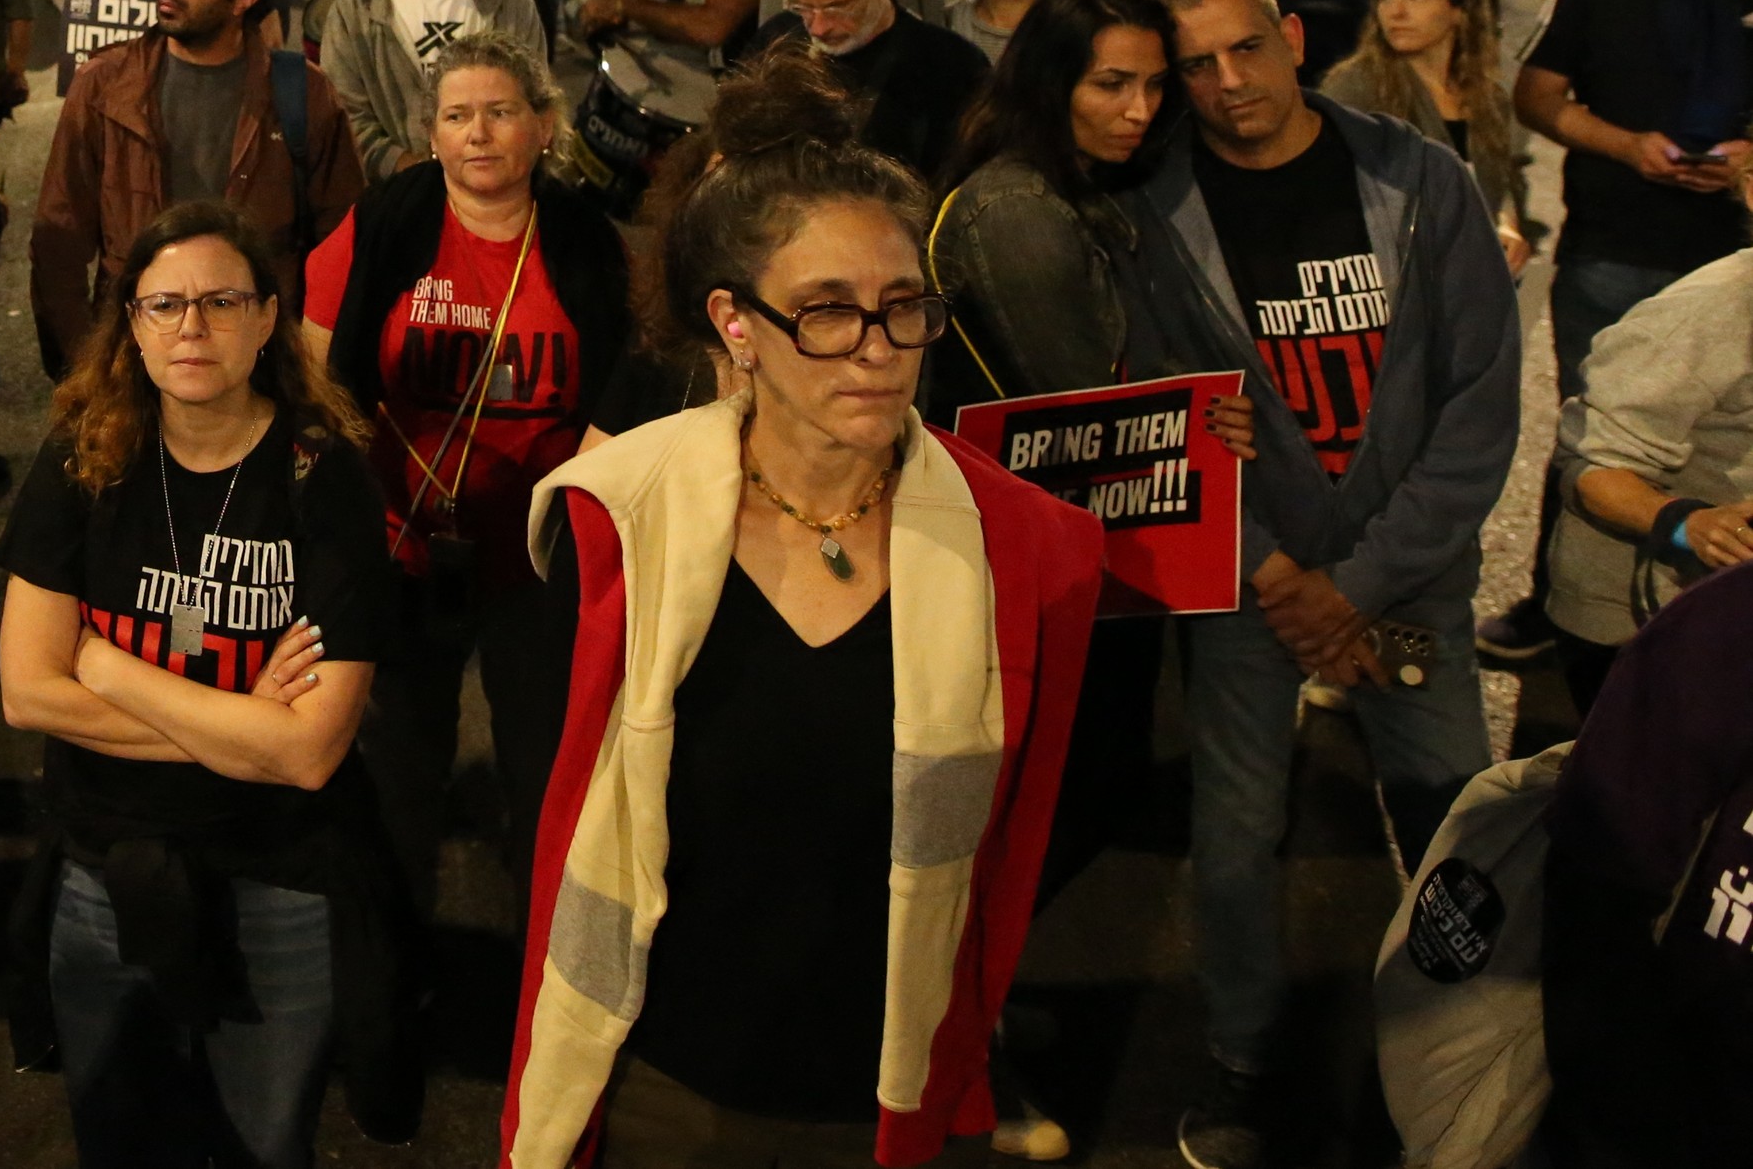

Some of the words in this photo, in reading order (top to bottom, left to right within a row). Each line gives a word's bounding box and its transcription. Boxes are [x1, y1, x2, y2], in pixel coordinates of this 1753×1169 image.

[409, 299, 447, 326] THEM
[451, 303, 491, 330] HOME
[1256, 296, 1335, 336] הביתה
[1009, 423, 1103, 471] BRING
[1114, 409, 1187, 456] THEM
[1087, 458, 1189, 520] NOW!!!
[201, 533, 295, 585] מחזירים
[227, 584, 295, 631] אותם
